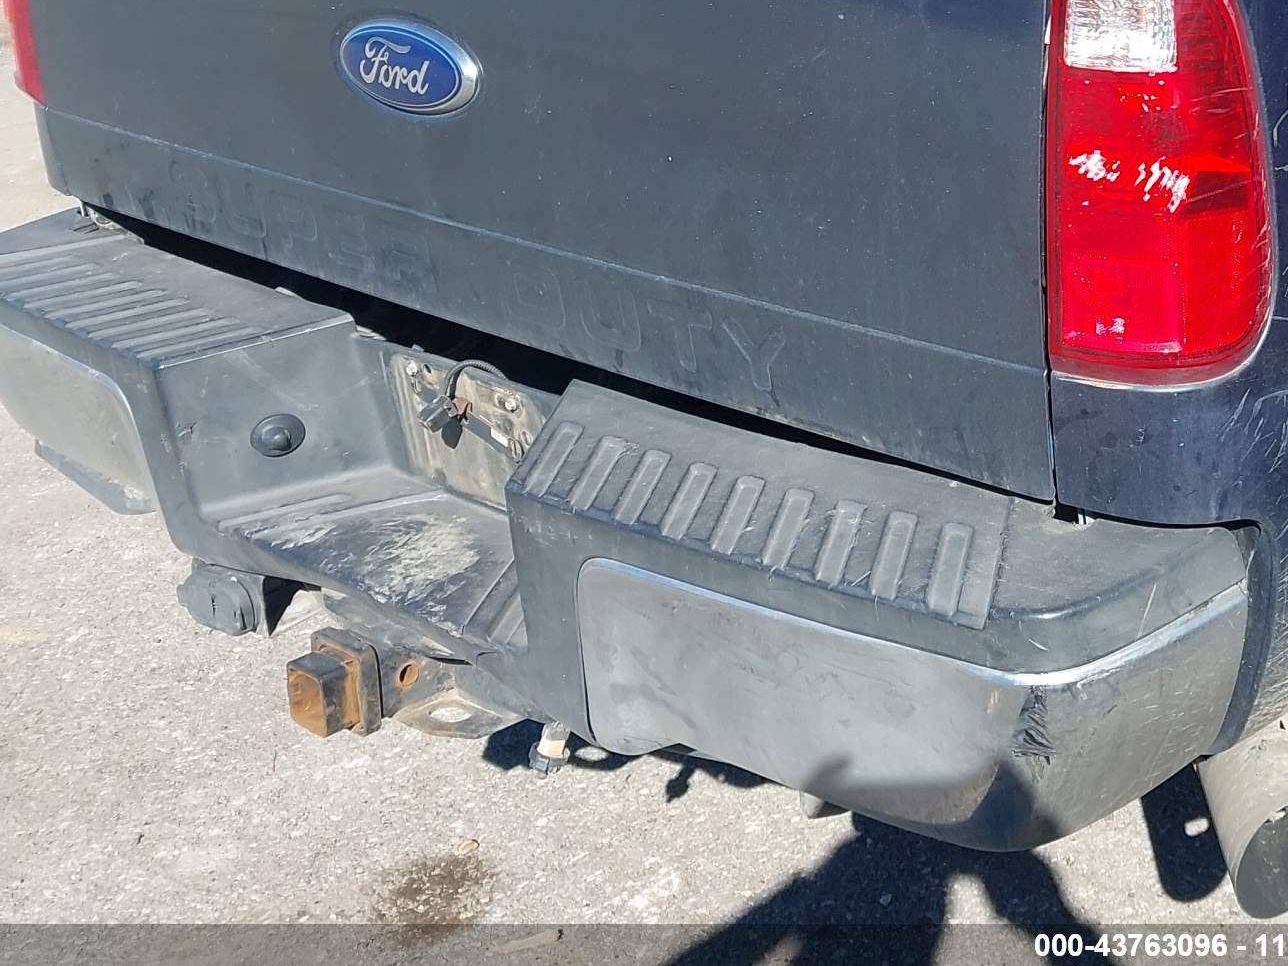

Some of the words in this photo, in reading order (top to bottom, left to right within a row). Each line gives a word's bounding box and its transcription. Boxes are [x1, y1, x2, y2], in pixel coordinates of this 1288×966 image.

[360, 37, 430, 95] Ford
[167, 160, 437, 294] SUPER
[500, 263, 787, 391] DUTY
